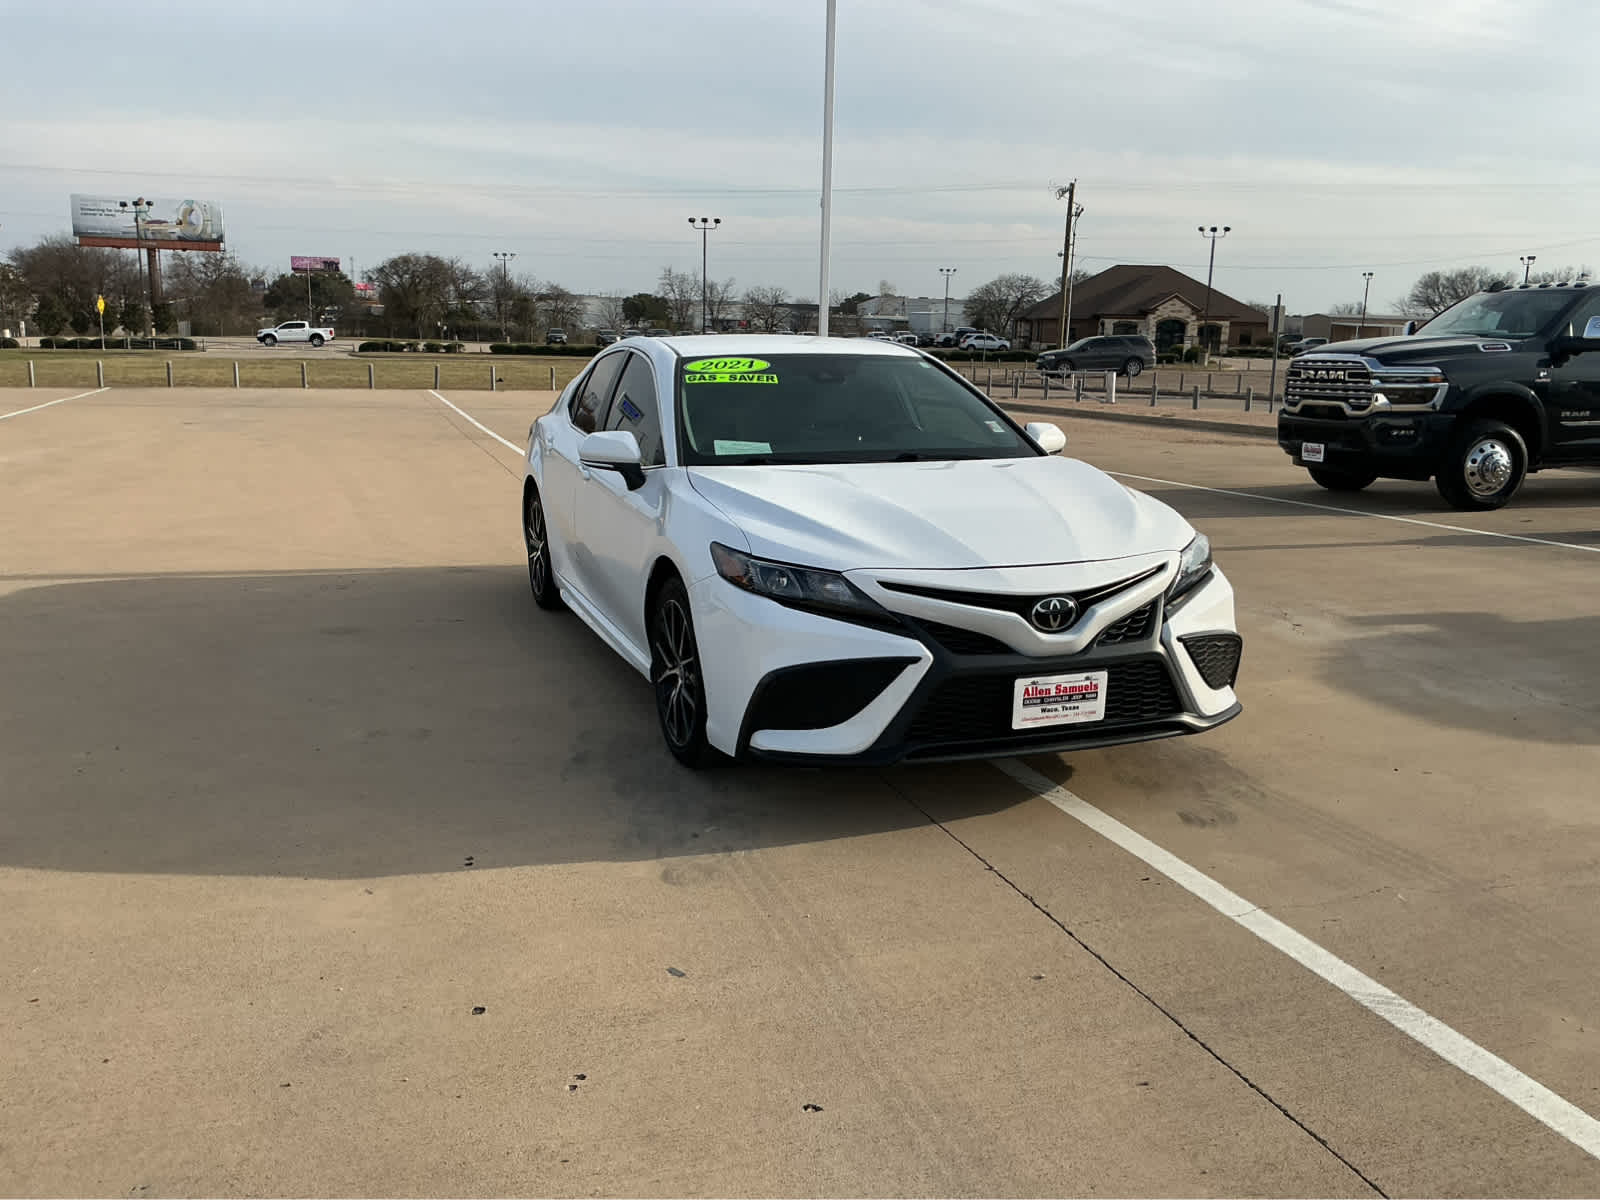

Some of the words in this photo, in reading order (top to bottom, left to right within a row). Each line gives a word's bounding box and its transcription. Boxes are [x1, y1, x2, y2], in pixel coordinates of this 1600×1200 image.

[701, 360, 755, 370] 2024
[1302, 370, 1345, 380] RAM
[1023, 686, 1051, 698] Allen
[1055, 681, 1099, 696] Samuels
